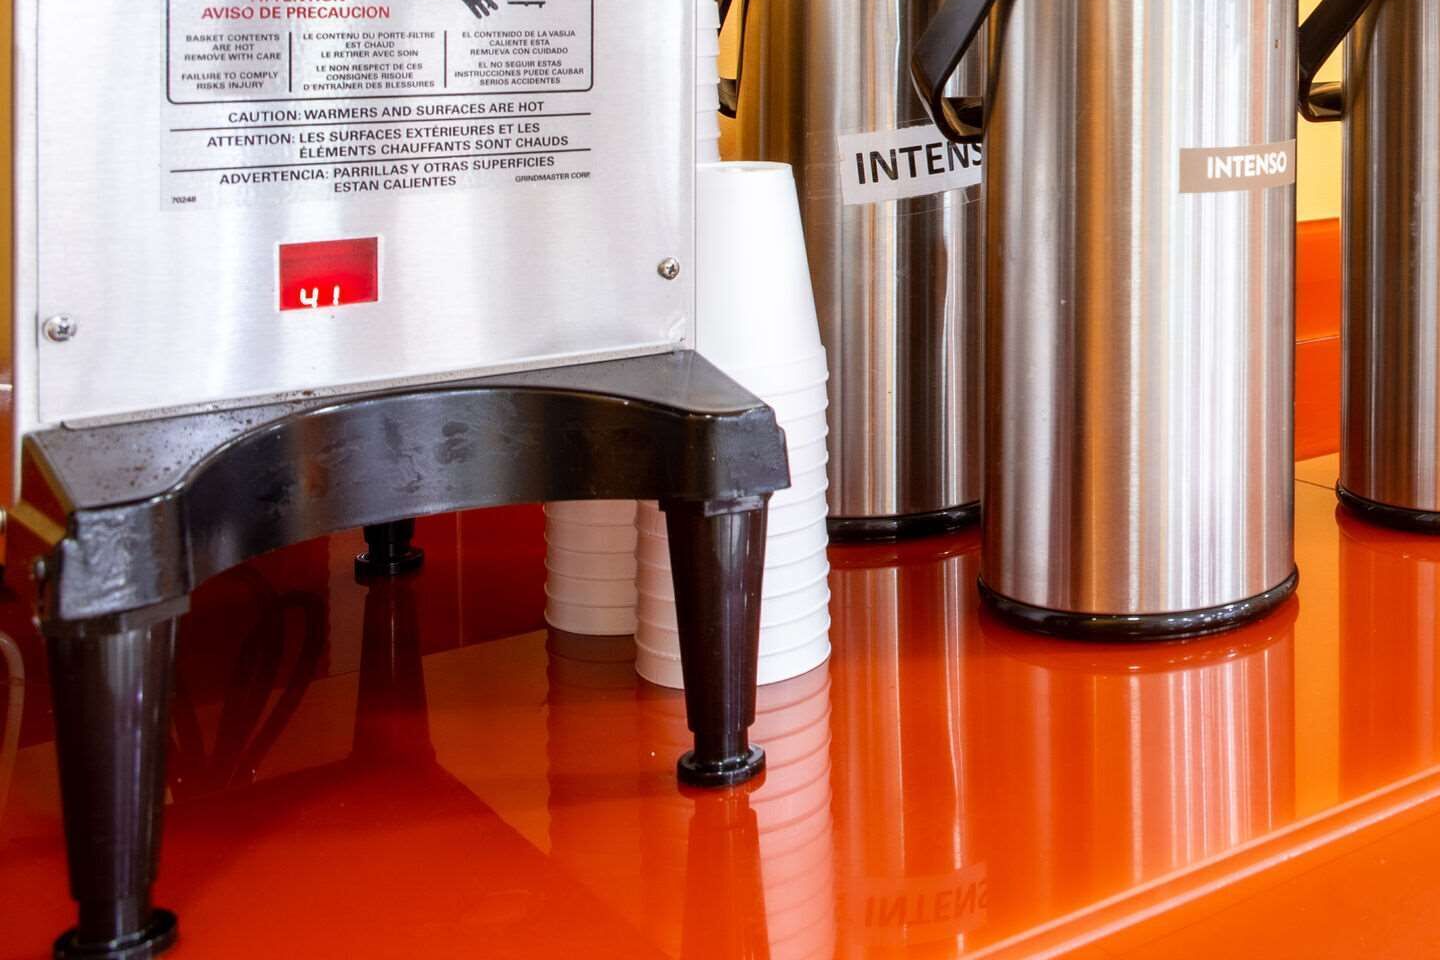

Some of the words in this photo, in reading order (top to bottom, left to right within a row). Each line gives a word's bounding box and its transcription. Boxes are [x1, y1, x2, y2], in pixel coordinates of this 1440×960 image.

[201, 7, 254, 19] AVISO
[259, 7, 281, 19] DE
[286, 5, 390, 19] PRECAUCION
[185, 34, 224, 42] BASKET
[227, 33, 280, 41] CONTENTS
[302, 32, 314, 40] LE
[315, 31, 360, 40] CONTENU
[362, 31, 375, 39] DU
[212, 43, 231, 51] ARE
[234, 43, 254, 51] HOT
[345, 41, 361, 49] EST
[320, 50, 331, 58] LE
[333, 50, 370, 58] RETIRER
[372, 50, 395, 58] AVEC
[470, 48, 510, 56] REMUEVA
[532, 47, 568, 55] CUIDADO
[184, 53, 226, 61] REMOVE
[256, 52, 281, 60] CARE
[329, 64, 349, 72] NON
[352, 64, 389, 72] RESPECT
[392, 63, 404, 71] DE
[505, 60, 535, 68] SEGUIR
[181, 72, 221, 80] FAILURE
[224, 71, 236, 79] TO
[239, 71, 278, 79] COMPLY
[326, 72, 379, 80] CONSIGNES
[454, 69, 521, 78] INSTRUCCIONES
[196, 82, 226, 90] RISKS
[228, 81, 264, 89] INJURY
[365, 81, 383, 89] DES
[385, 80, 435, 89] BLESSURES
[479, 78, 509, 86] SERIOS
[511, 77, 561, 86] ACCIDENTES
[228, 110, 301, 124] CAUTION:
[304, 107, 378, 121] WARMERS
[382, 106, 412, 117] AND
[416, 103, 486, 116] SURFACES
[489, 103, 514, 113] ARE
[518, 101, 545, 113] HOT
[206, 132, 295, 148] ATTENTION:
[299, 132, 325, 144] LES
[329, 128, 402, 143] SURFACES
[406, 123, 495, 138] EXTÉRIEURES
[499, 123, 514, 134] ET
[518, 122, 540, 133] LES
[299, 145, 376, 159] ÉLÉMENTS
[381, 140, 472, 155] CHAUFFANTS
[475, 138, 512, 150] SONT
[515, 136, 569, 148] CHAUDS
[1206, 151, 1288, 179] INTENSO
[219, 169, 329, 185] ADVERTENCIA:
[333, 164, 409, 178] PARRILLAS
[411, 164, 420, 174] Y
[423, 161, 469, 173] OTRAS
[472, 156, 555, 170] SUPERFICIES
[515, 173, 570, 183] GRINDMASTER
[334, 180, 379, 193] ESTAN
[383, 176, 457, 190] CALIENTES
